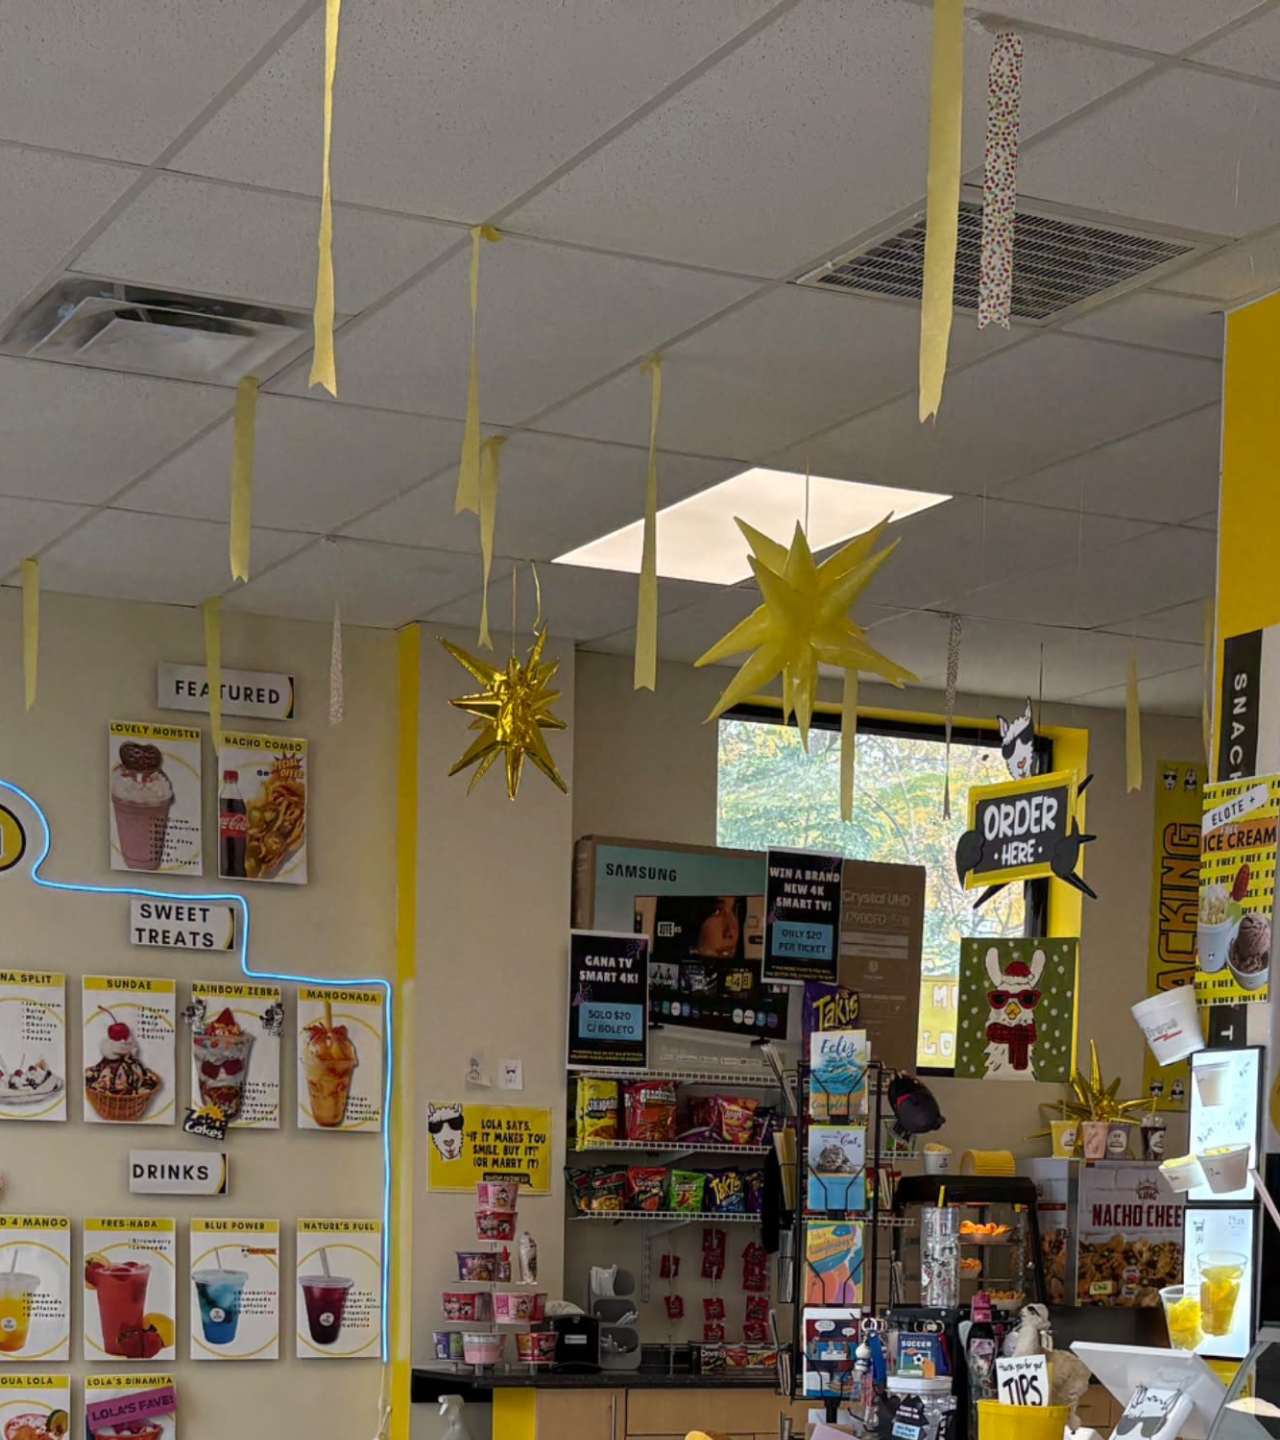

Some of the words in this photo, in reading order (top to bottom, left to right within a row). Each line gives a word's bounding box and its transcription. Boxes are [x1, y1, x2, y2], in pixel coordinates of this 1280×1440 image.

[224, 737, 261, 749] NACHO
[984, 796, 1059, 840] ORDER
[1211, 800, 1244, 826] ELOTE
[1204, 833, 1224, 852] ICE
[1227, 829, 1276, 850] CREAM
[1001, 839, 1035, 865] HERE
[605, 862, 677, 882] SAMSUNG
[770, 867, 793, 879] WIN
[795, 869, 803, 880] A
[805, 869, 841, 883] BRAND
[784, 882, 808, 895] NEW
[810, 884, 824, 896] 4K
[776, 897, 812, 911] SMART
[815, 899, 832, 912] TV!
[140, 903, 210, 923] SWEET
[135, 927, 214, 948] TREATS
[781, 928, 805, 939] ONLY
[778, 941, 796, 952] PER
[798, 943, 827, 954] TICKET
[585, 955, 616, 969] GANA
[618, 957, 633, 969] TV
[20, 973, 53, 985] SPLIT
[579, 970, 617, 983] SMART
[619, 972, 639, 984] 4K!
[106, 978, 153, 991] SUNDAE
[191, 983, 243, 997] RAINBOW
[246, 985, 281, 998] ZEBRA
[306, 989, 378, 1003] MANGONADA
[588, 1009, 613, 1020] SOLO
[812, 991, 860, 1031] Takis
[597, 1024, 635, 1035] BOLETO
[184, 1121, 225, 1140] Cakes
[481, 1119, 503, 1130] LOLA
[494, 1132, 524, 1143] MAKES
[132, 1162, 210, 1182] DRINKS
[710, 1170, 743, 1206] Takis
[11, 1217, 18, 1226] 4
[22, 1217, 68, 1228] MANGO
[1092, 1203, 1143, 1228] NACHO
[100, 1219, 158, 1229] FRES-NADA
[204, 1221, 228, 1231] BLUE
[231, 1221, 265, 1231] POWER
[303, 1221, 349, 1231] NATURE'S
[353, 1222, 375, 1232] FUEL
[900, 1339, 932, 1349] SOCCER
[26, 1376, 54, 1386] LOLA
[87, 1377, 122, 1386] LOLA'S
[125, 1376, 173, 1386] DINAMITA
[1001, 1373, 1043, 1407] TIPS
[92, 1402, 137, 1421] LOLA'S
[138, 1394, 175, 1411] FAVE!
